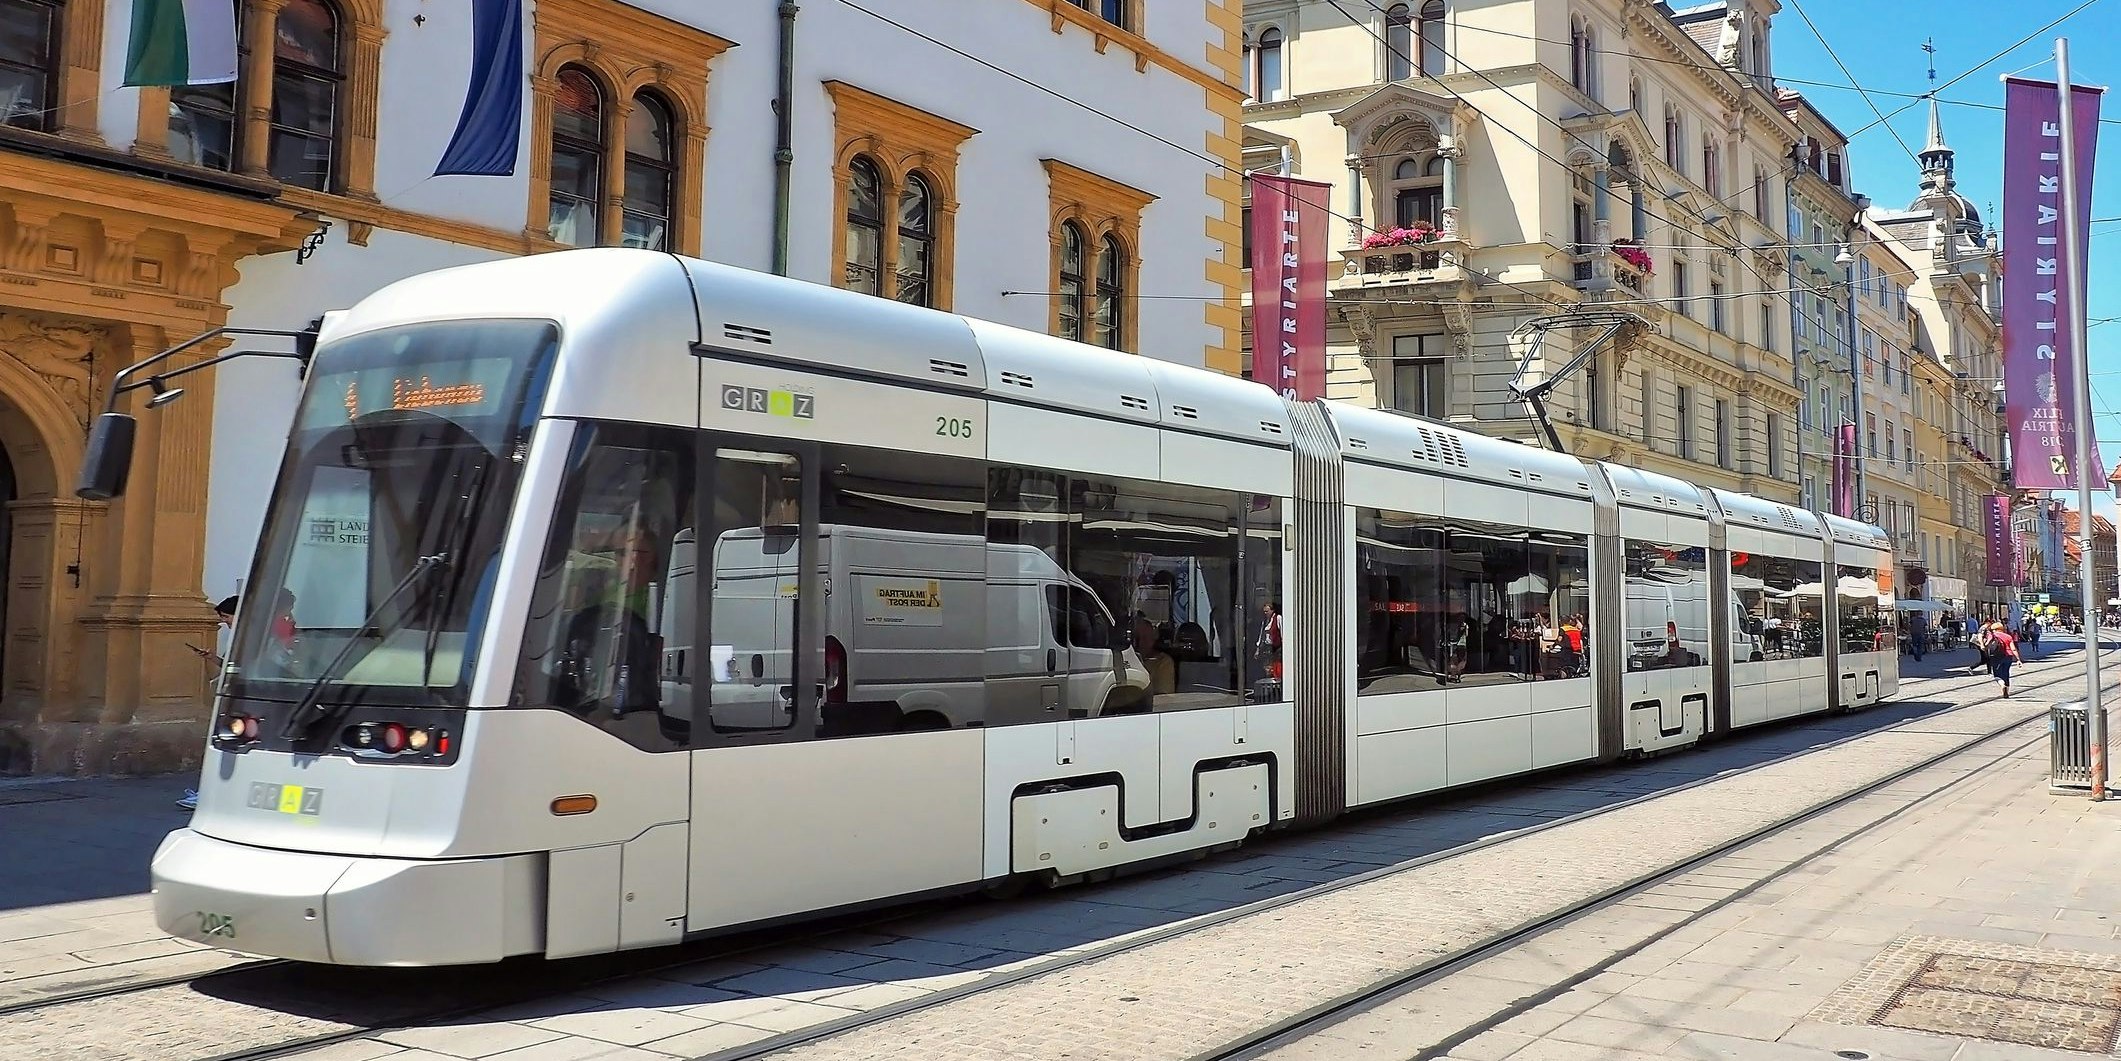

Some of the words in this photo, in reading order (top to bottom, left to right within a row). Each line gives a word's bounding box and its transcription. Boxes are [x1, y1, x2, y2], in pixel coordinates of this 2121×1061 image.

[1283, 210, 1298, 401] STYRIARTE
[936, 416, 972, 439] 205
[195, 910, 236, 939] 205
